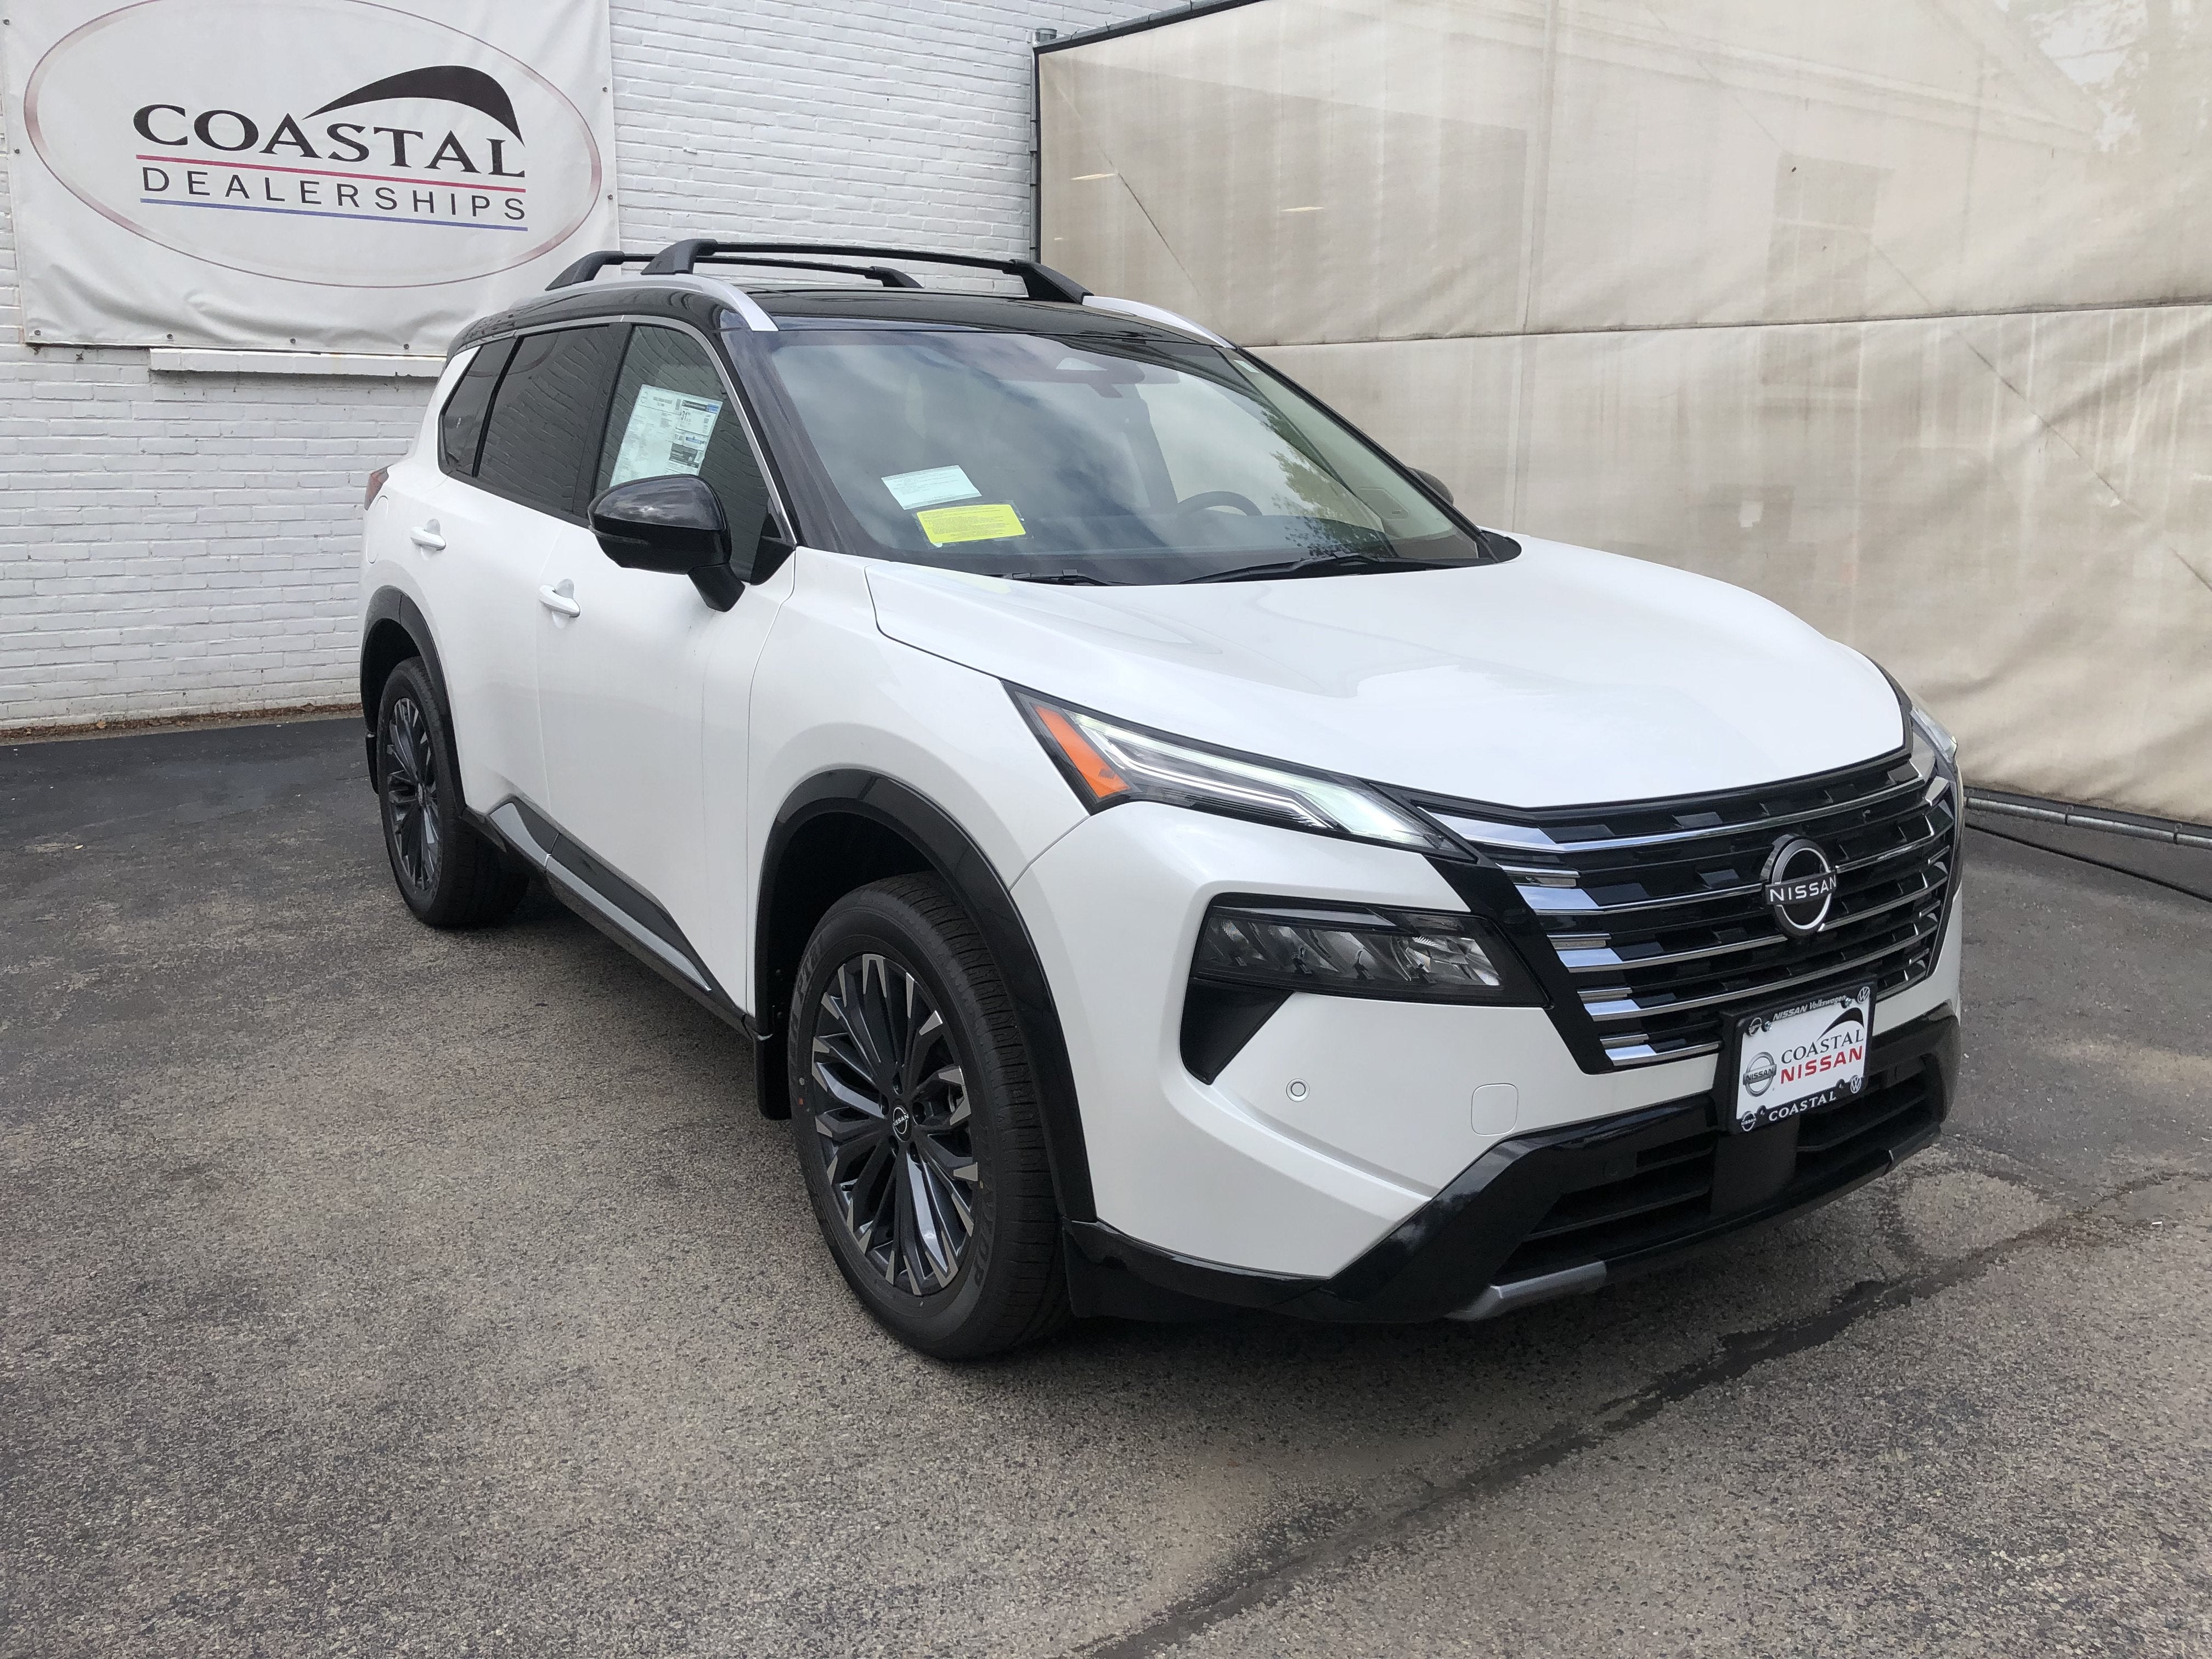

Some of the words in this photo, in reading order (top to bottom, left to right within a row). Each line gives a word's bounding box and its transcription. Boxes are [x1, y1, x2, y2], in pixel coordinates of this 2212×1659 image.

[133, 104, 526, 178] COASTAL
[142, 166, 525, 221] DEALERSHIPS
[1769, 875, 1837, 902] NISSAN
[1773, 1005, 1808, 1021] NISSAN
[1781, 1029, 1864, 1064] COASTAL
[1746, 1066, 1775, 1081] NISSAN
[1780, 1045, 1863, 1085] NISSAN
[1769, 1090, 1837, 1121] COASTAL
